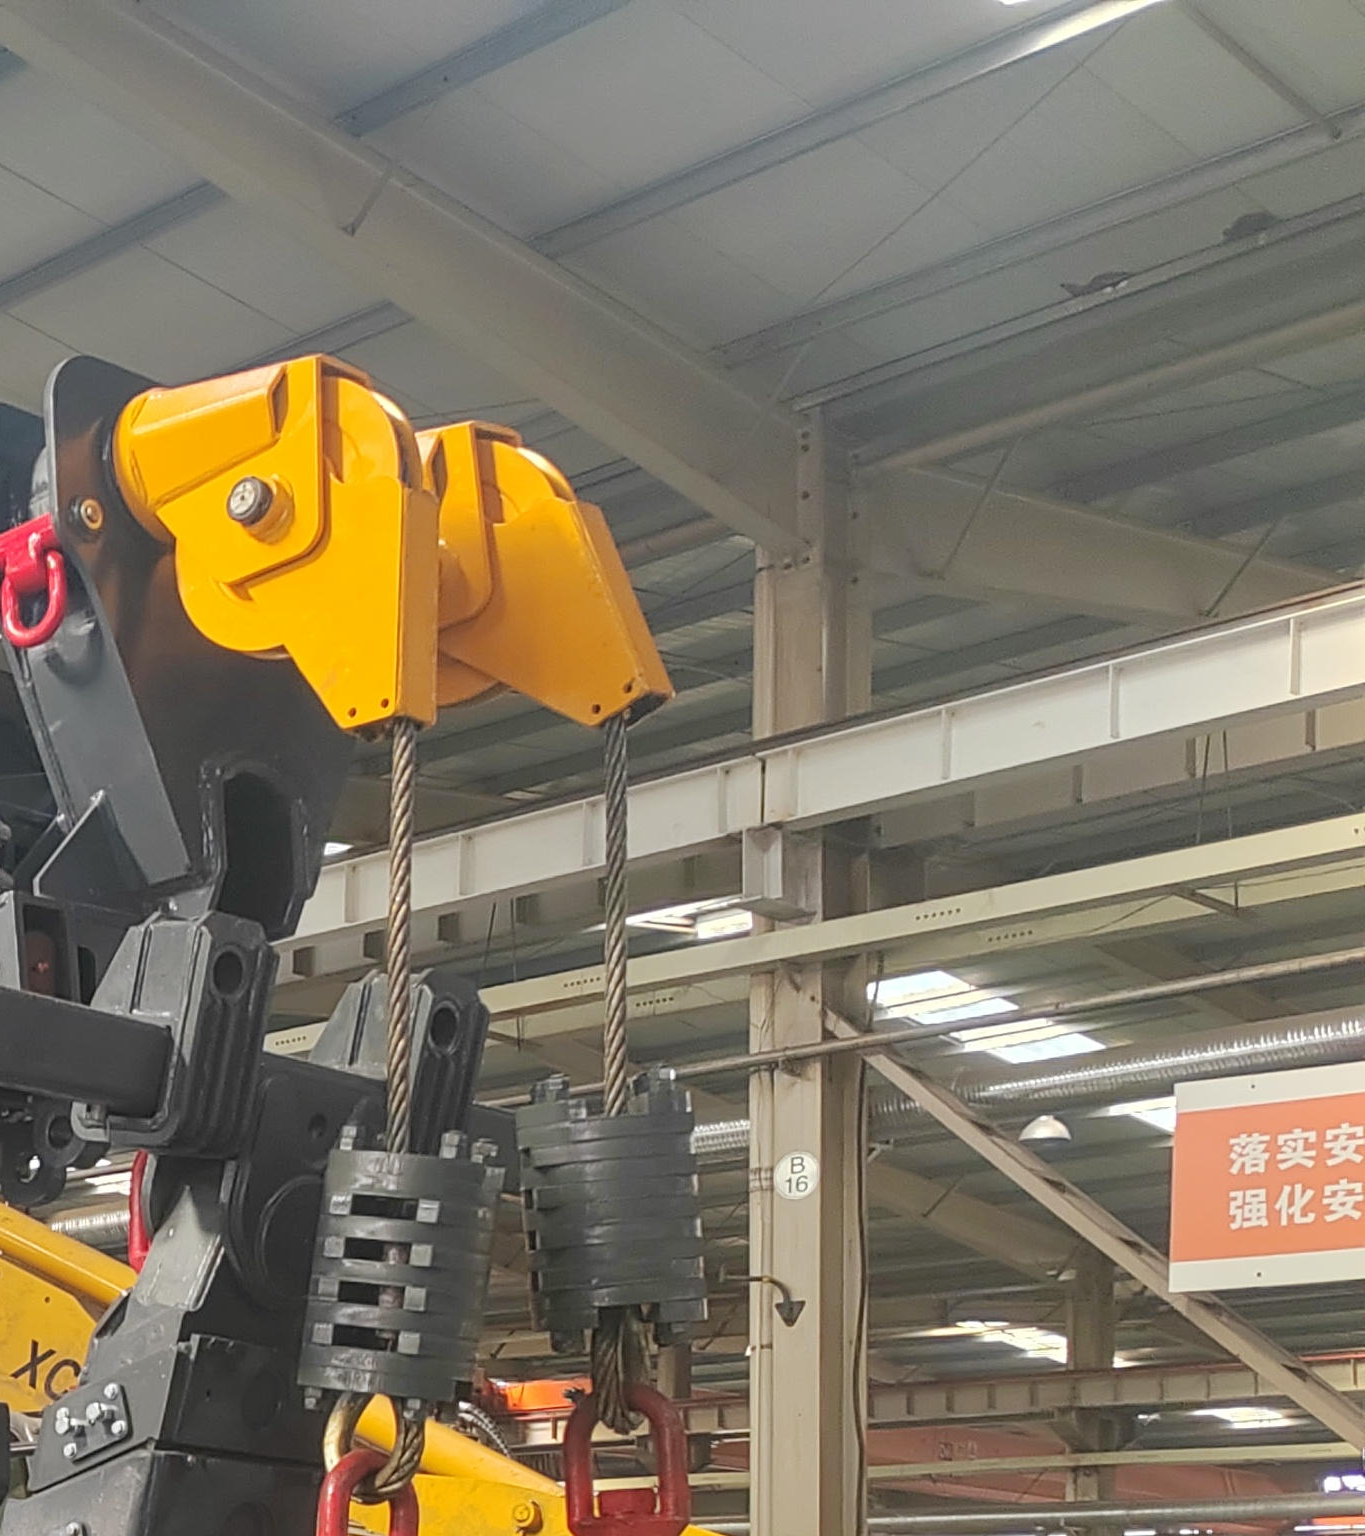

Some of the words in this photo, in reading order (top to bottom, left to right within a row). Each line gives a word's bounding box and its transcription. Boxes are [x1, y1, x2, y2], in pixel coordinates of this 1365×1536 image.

[791, 1156, 805, 1174] B
[1229, 1122, 1365, 1175] 落实安
[784, 1175, 808, 1194] 16
[1229, 1178, 1365, 1230] 强化安
